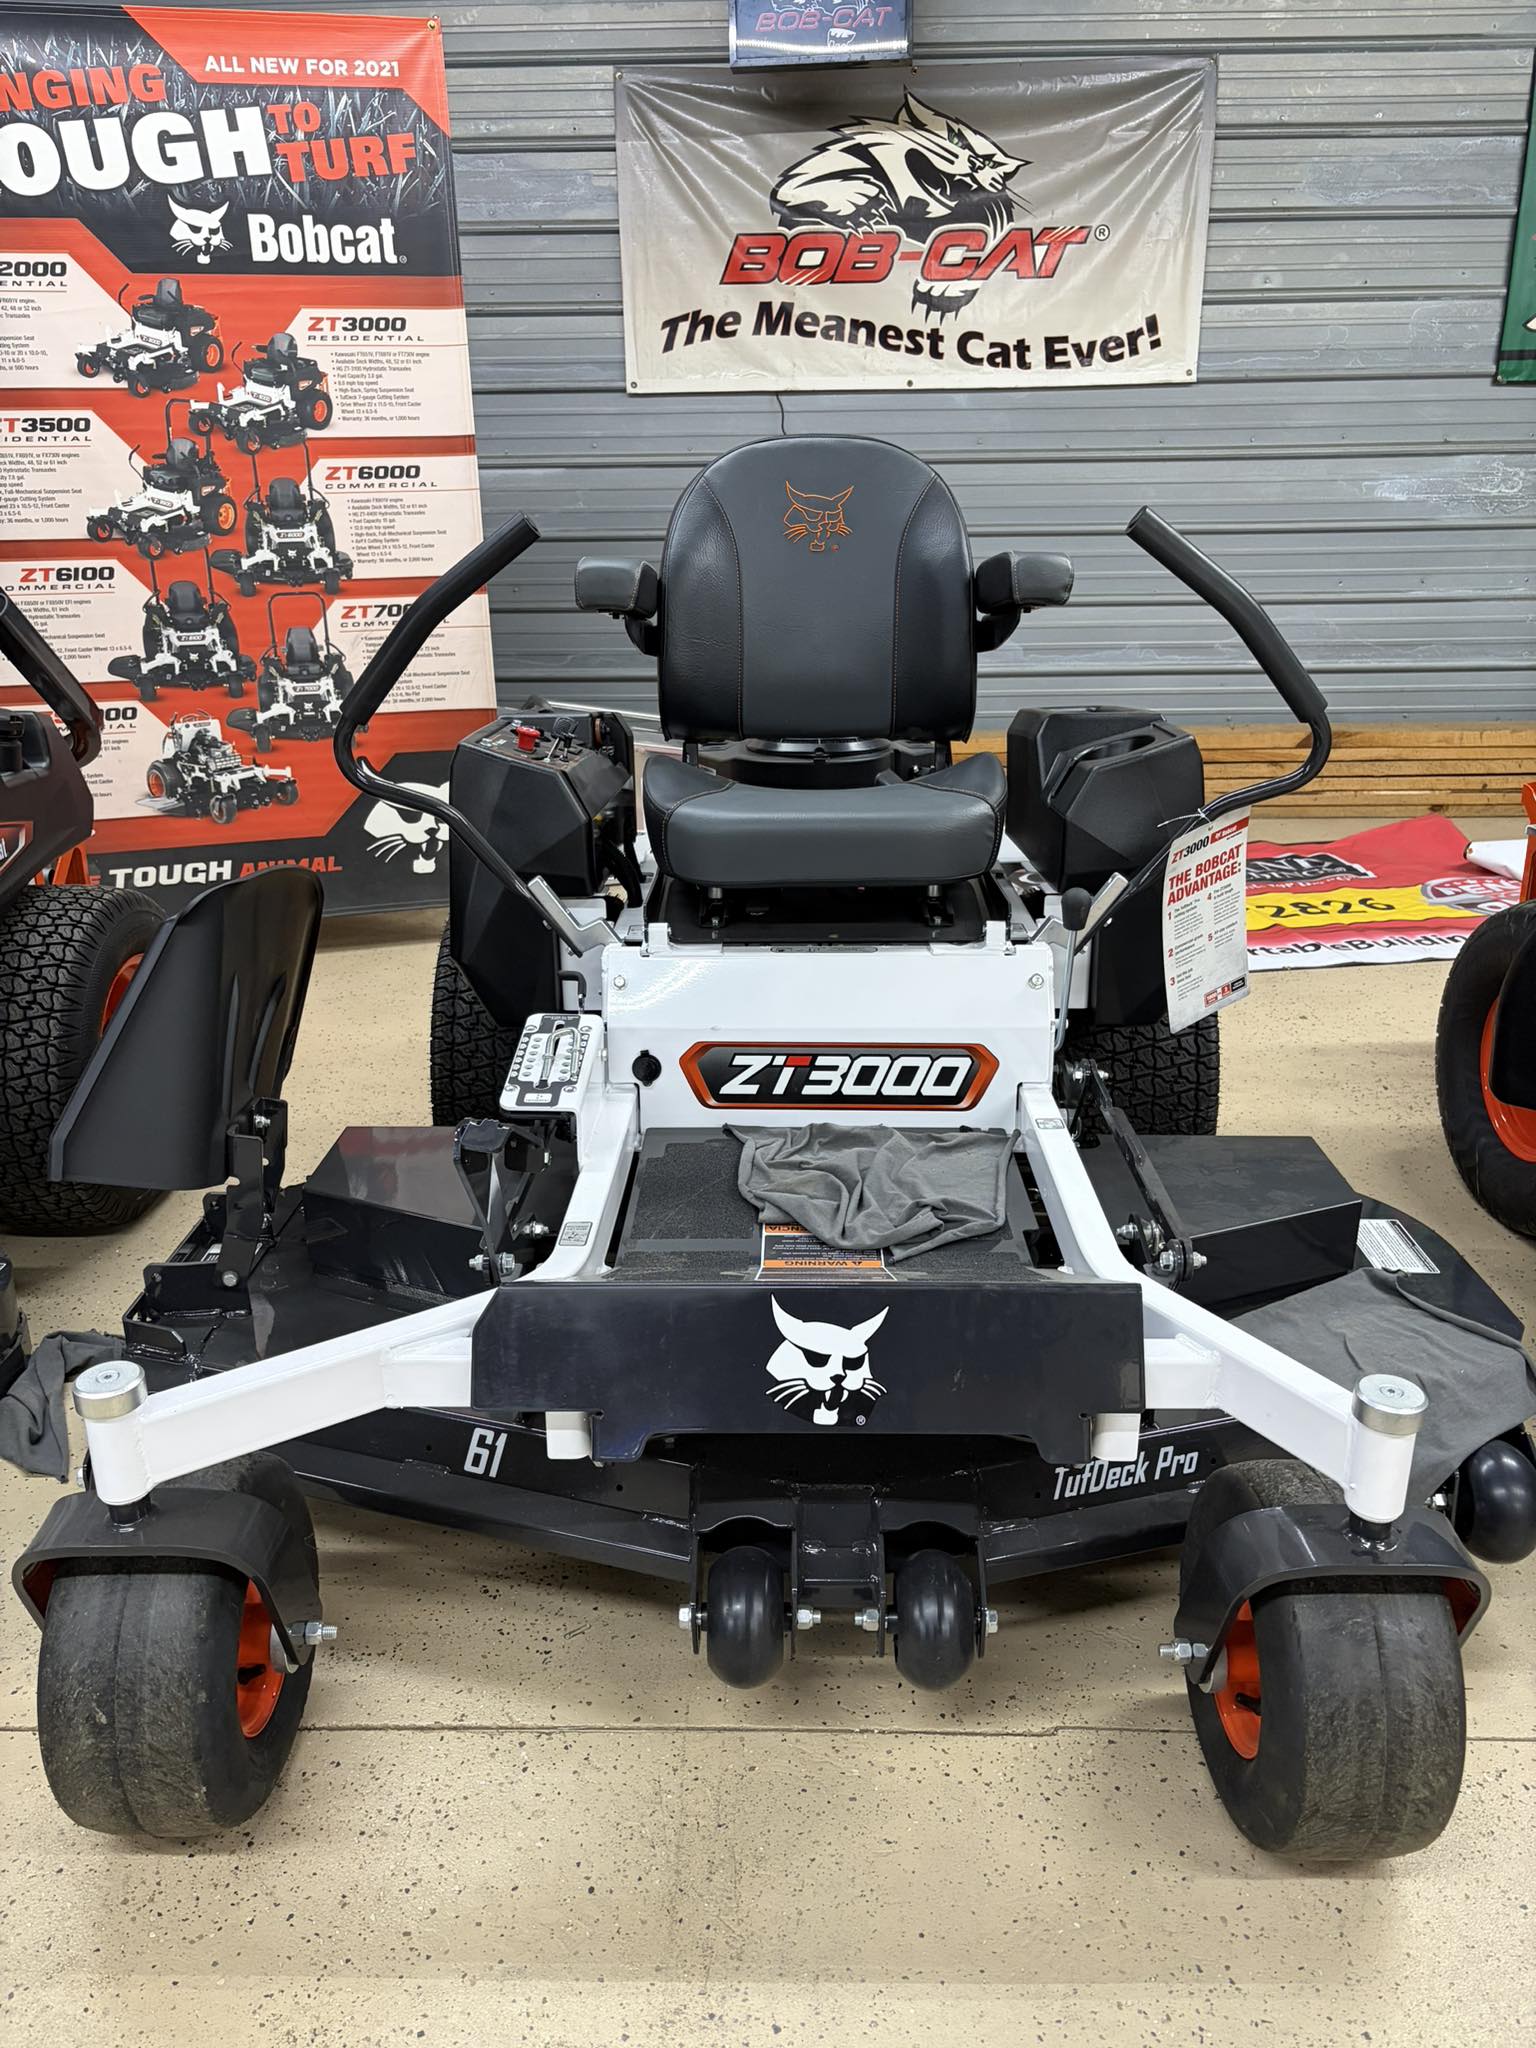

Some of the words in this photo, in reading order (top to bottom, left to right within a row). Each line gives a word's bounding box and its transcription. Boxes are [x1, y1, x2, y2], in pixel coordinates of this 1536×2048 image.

[755, 6, 893, 33] BOB-CAT
[205, 55, 243, 73] ALL
[251, 57, 300, 75] NEW
[306, 58, 347, 76] FOR
[354, 60, 399, 77] 2021
[267, 102, 321, 135] TO
[275, 132, 416, 182] TURF
[307, 316, 407, 332] ZT3000
[659, 309, 741, 354] The
[752, 301, 945, 360] Meanest
[957, 330, 1031, 369] Cat
[1044, 314, 1163, 370] Ever!
[0, 417, 91, 433] T3500
[325, 465, 421, 481] ZT6000
[325, 481, 438, 490] COMMERCIAL
[20, 566, 115, 583] ZT6100
[2, 583, 116, 592] OMMERCIAL
[340, 618, 449, 628] COMMEL
[341, 603, 412, 619] ZT70
[1171, 836, 1210, 864] ZT3000
[108, 860, 232, 889] TOUGH
[1168, 868, 1192, 890] THE
[1195, 844, 1242, 878] BOBCAT
[1167, 861, 1241, 906] ADVANTAGE:
[1254, 898, 1396, 919] 2826
[1247, 935, 1467, 956] rtableBuildin
[719, 1054, 973, 1097] ZT3000
[463, 1427, 508, 1479] 61
[1053, 1450, 1150, 1501] TufDeck
[1154, 1445, 1199, 1481] Pro
